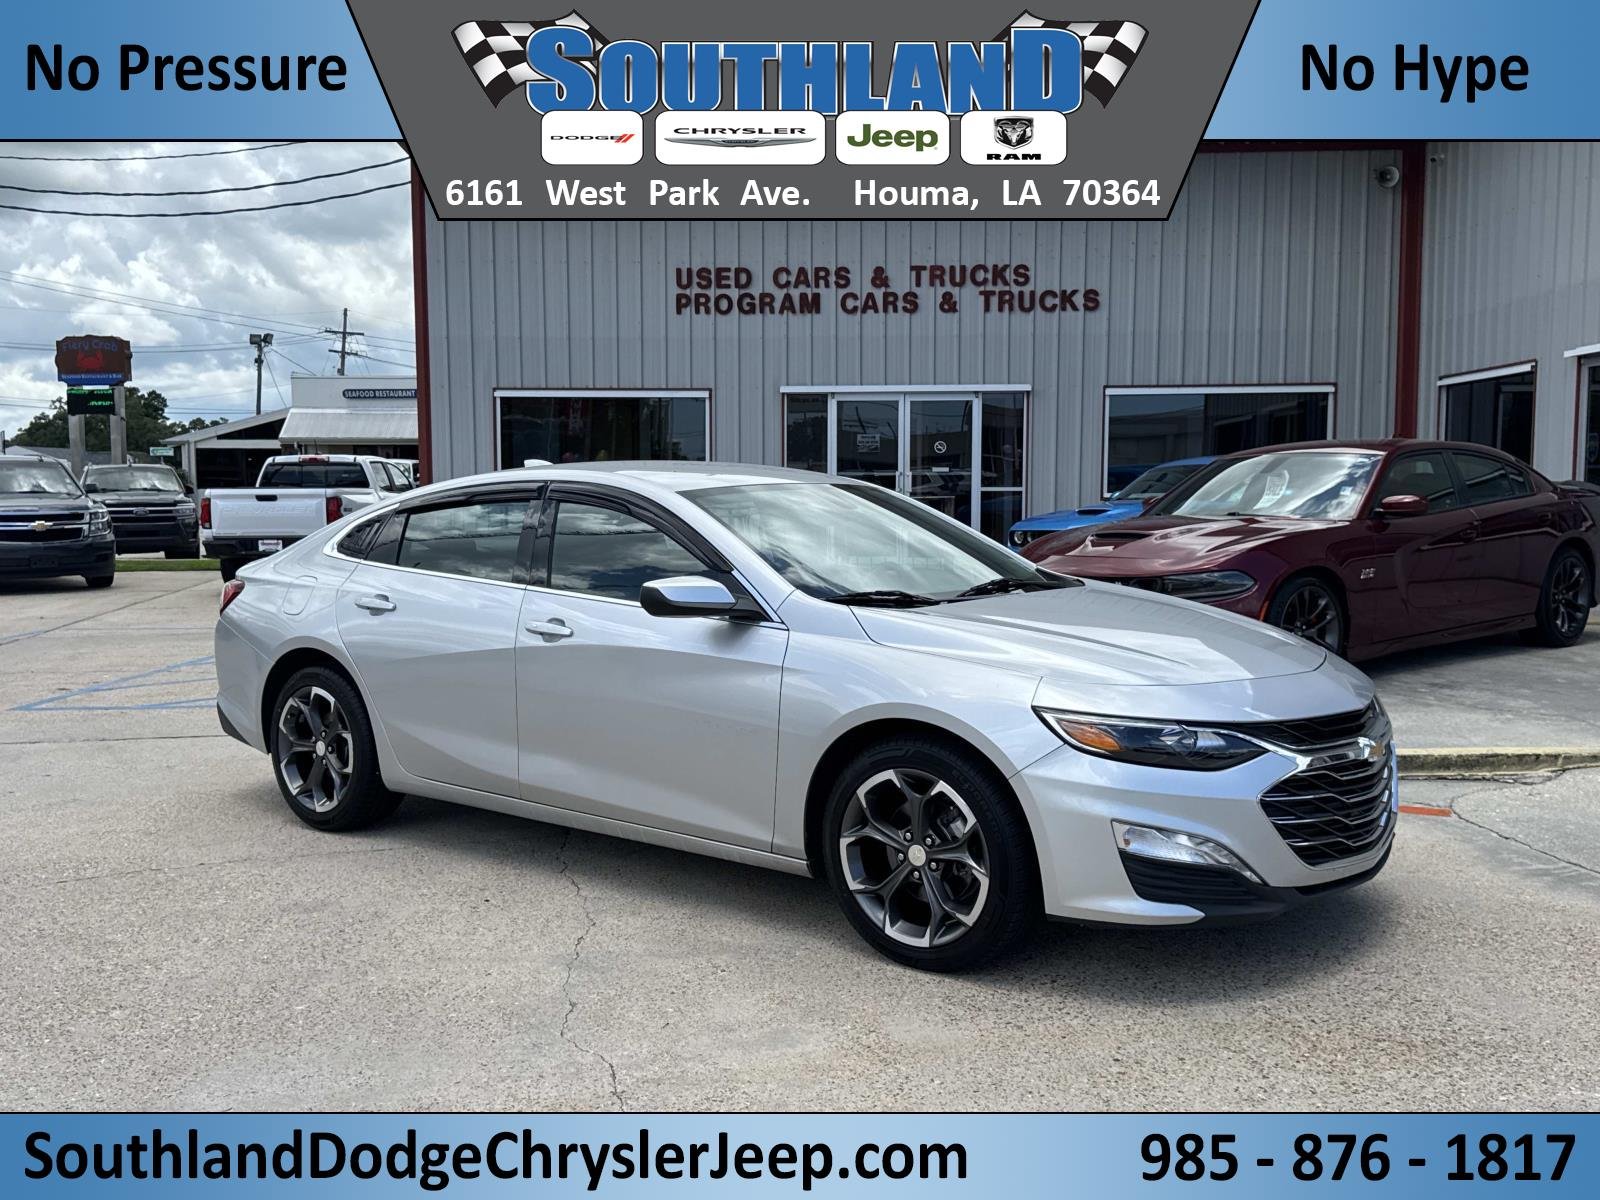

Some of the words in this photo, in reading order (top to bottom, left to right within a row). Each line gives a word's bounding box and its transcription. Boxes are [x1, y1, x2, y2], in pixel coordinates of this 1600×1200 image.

[676, 267, 752, 290] USED
[772, 266, 851, 289] CARS
[871, 266, 891, 289] &
[910, 264, 1031, 287] TRUCKS
[675, 292, 822, 316] PROGRAM
[840, 291, 920, 315] CARS
[939, 291, 959, 314] &
[979, 289, 1101, 314] TRUCKS
[344, 390, 375, 398] SEAFOOD
[375, 390, 416, 398] RESTAURANT
